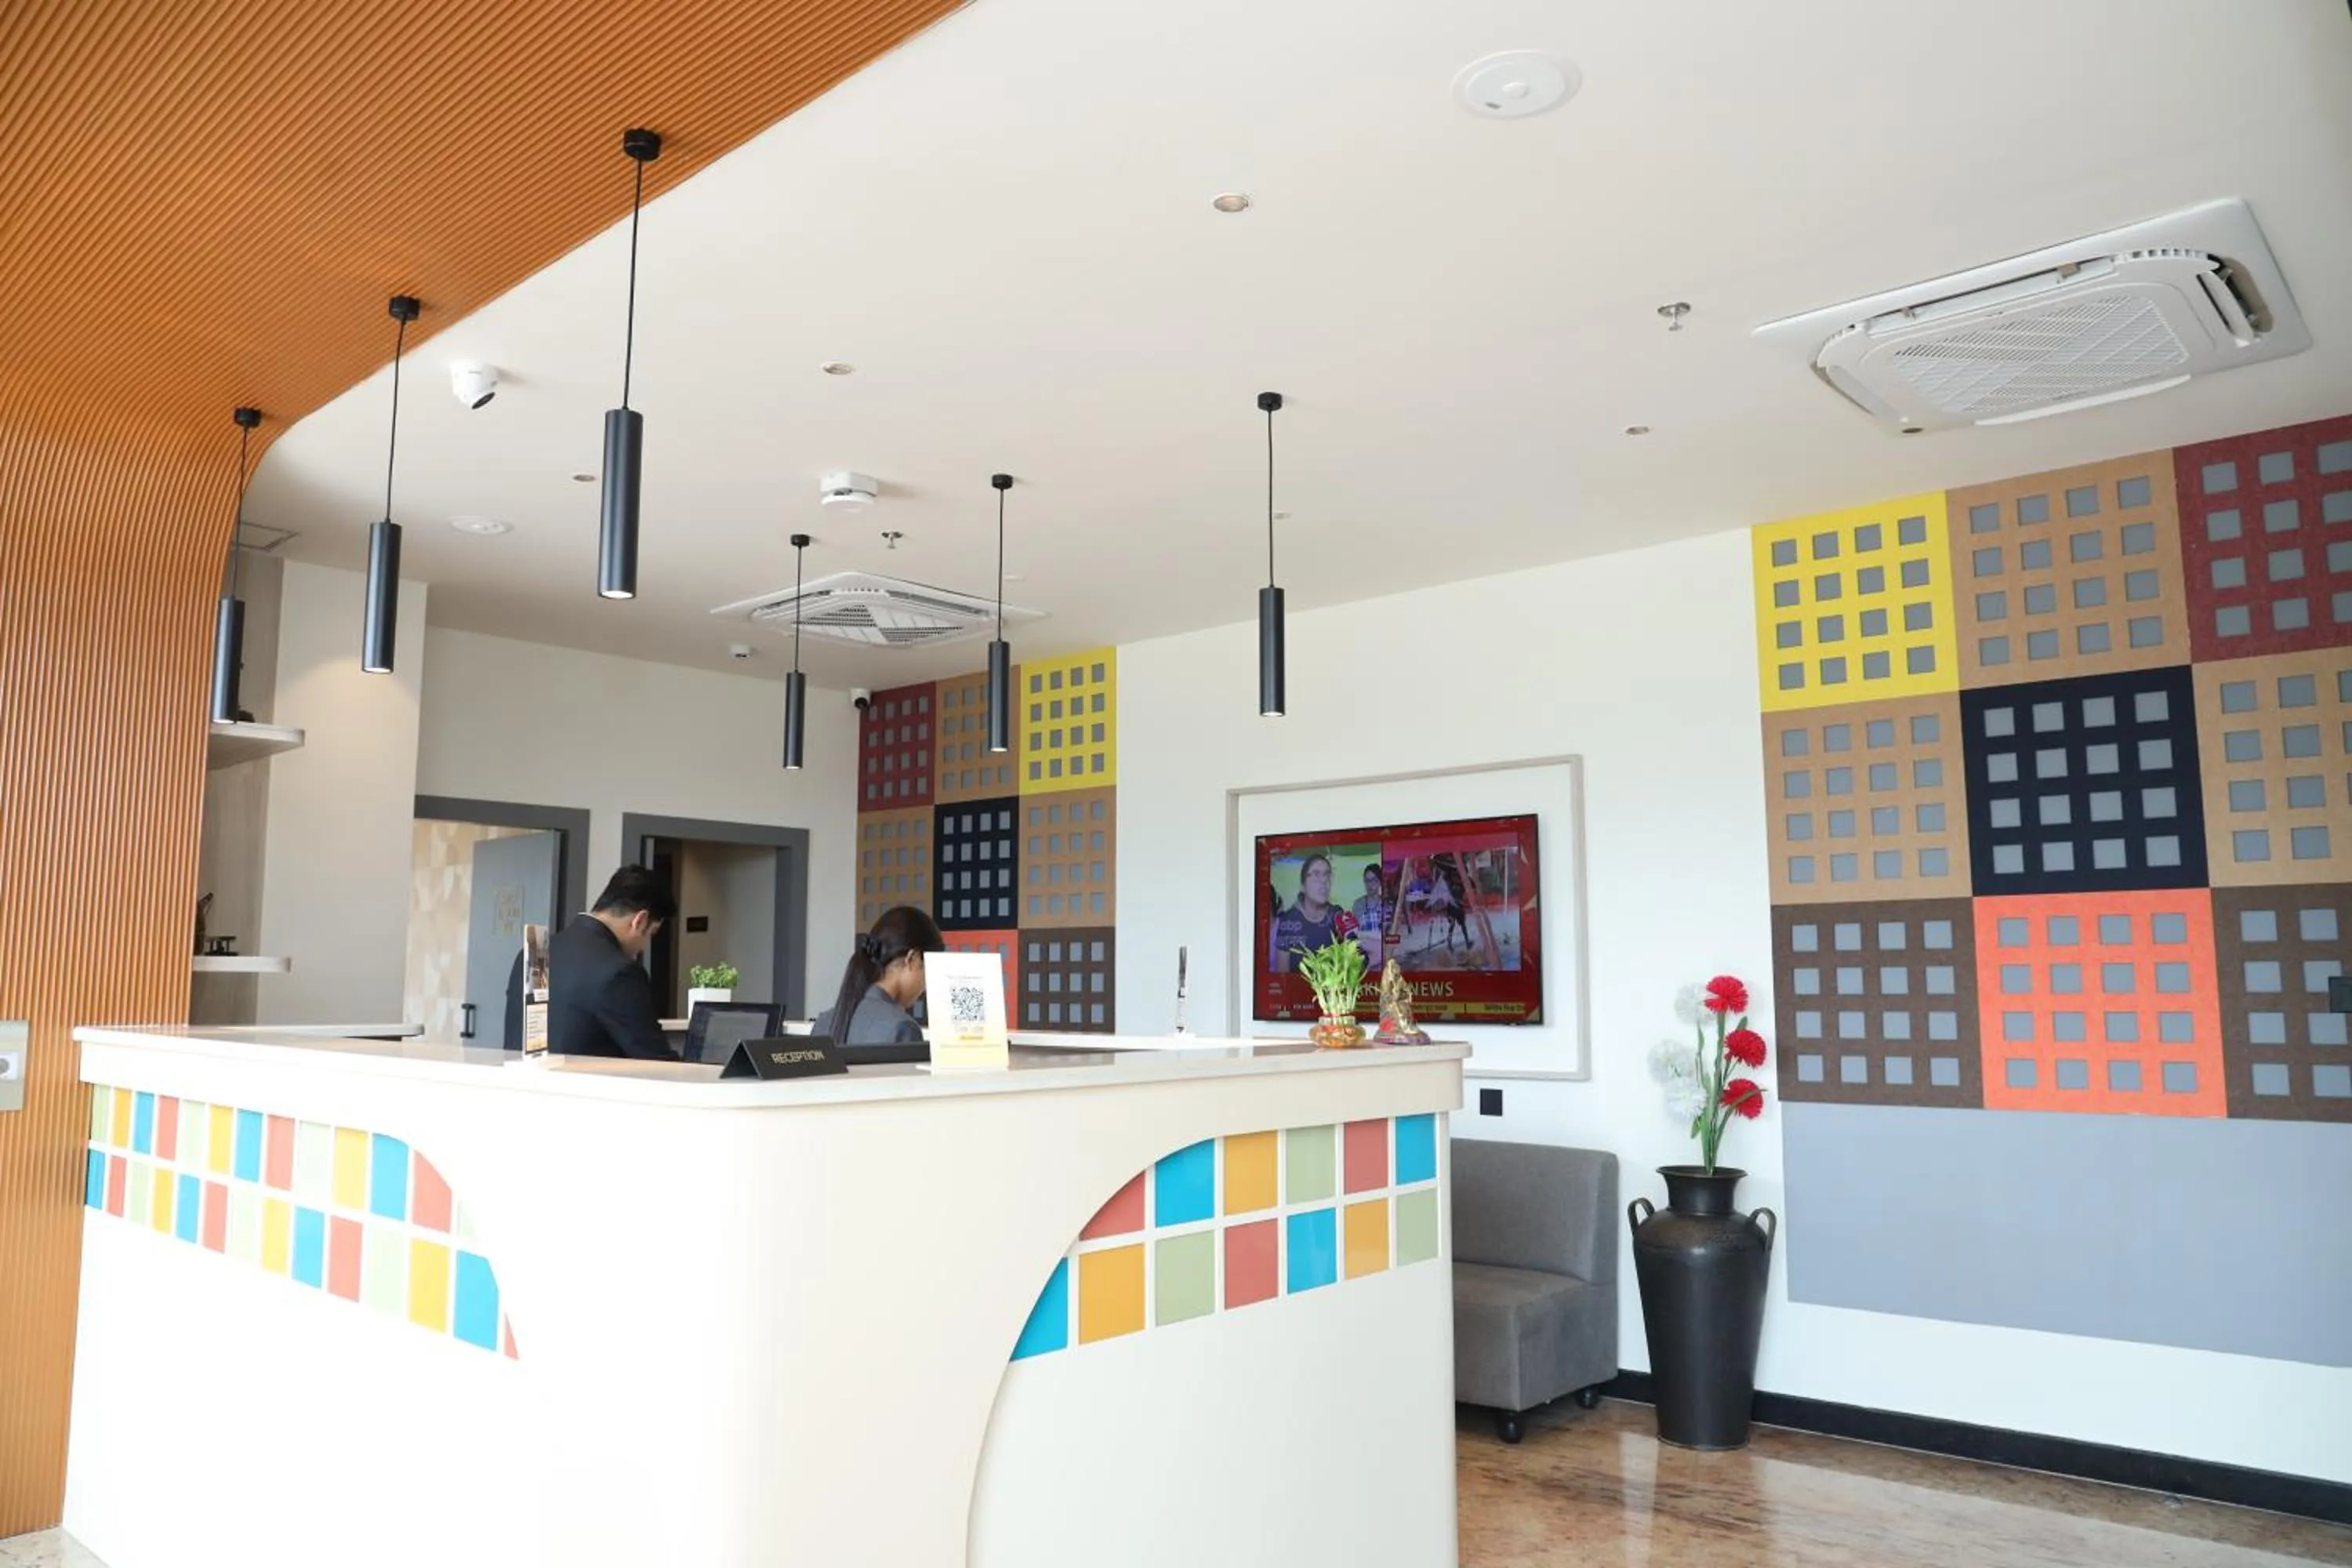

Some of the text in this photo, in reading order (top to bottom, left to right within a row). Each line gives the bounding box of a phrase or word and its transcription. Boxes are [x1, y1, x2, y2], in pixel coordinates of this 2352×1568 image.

[1279, 920, 1302, 933] abp
[1410, 981, 1454, 997] NEWS
[770, 1050, 826, 1064] RECEPTION
